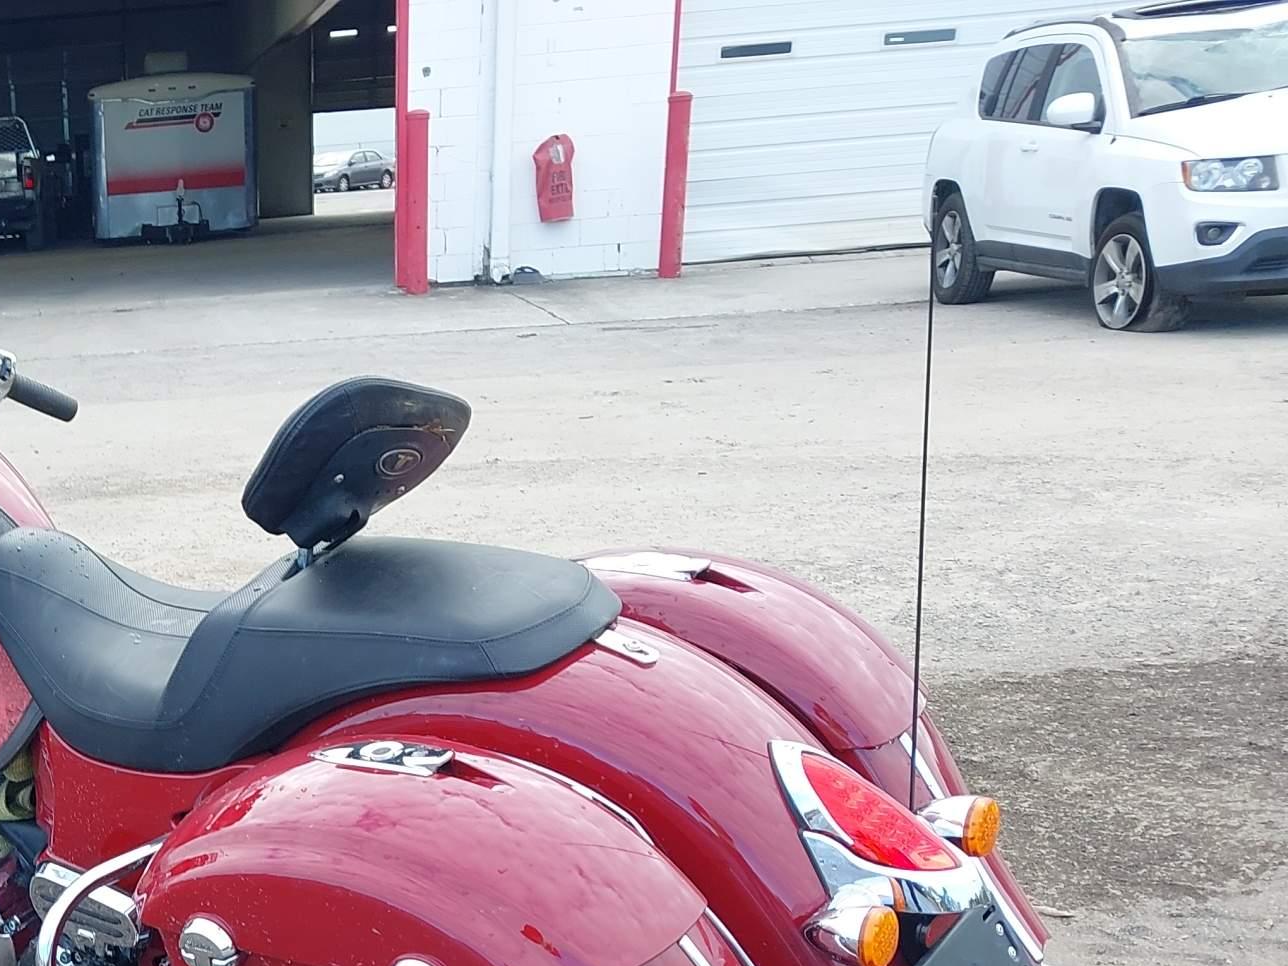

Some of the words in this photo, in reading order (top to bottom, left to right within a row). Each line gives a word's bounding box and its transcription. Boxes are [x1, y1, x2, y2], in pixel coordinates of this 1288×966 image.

[138, 108, 155, 117] CAT
[155, 104, 199, 116] RESPONSE
[200, 102, 224, 113] TEAM
